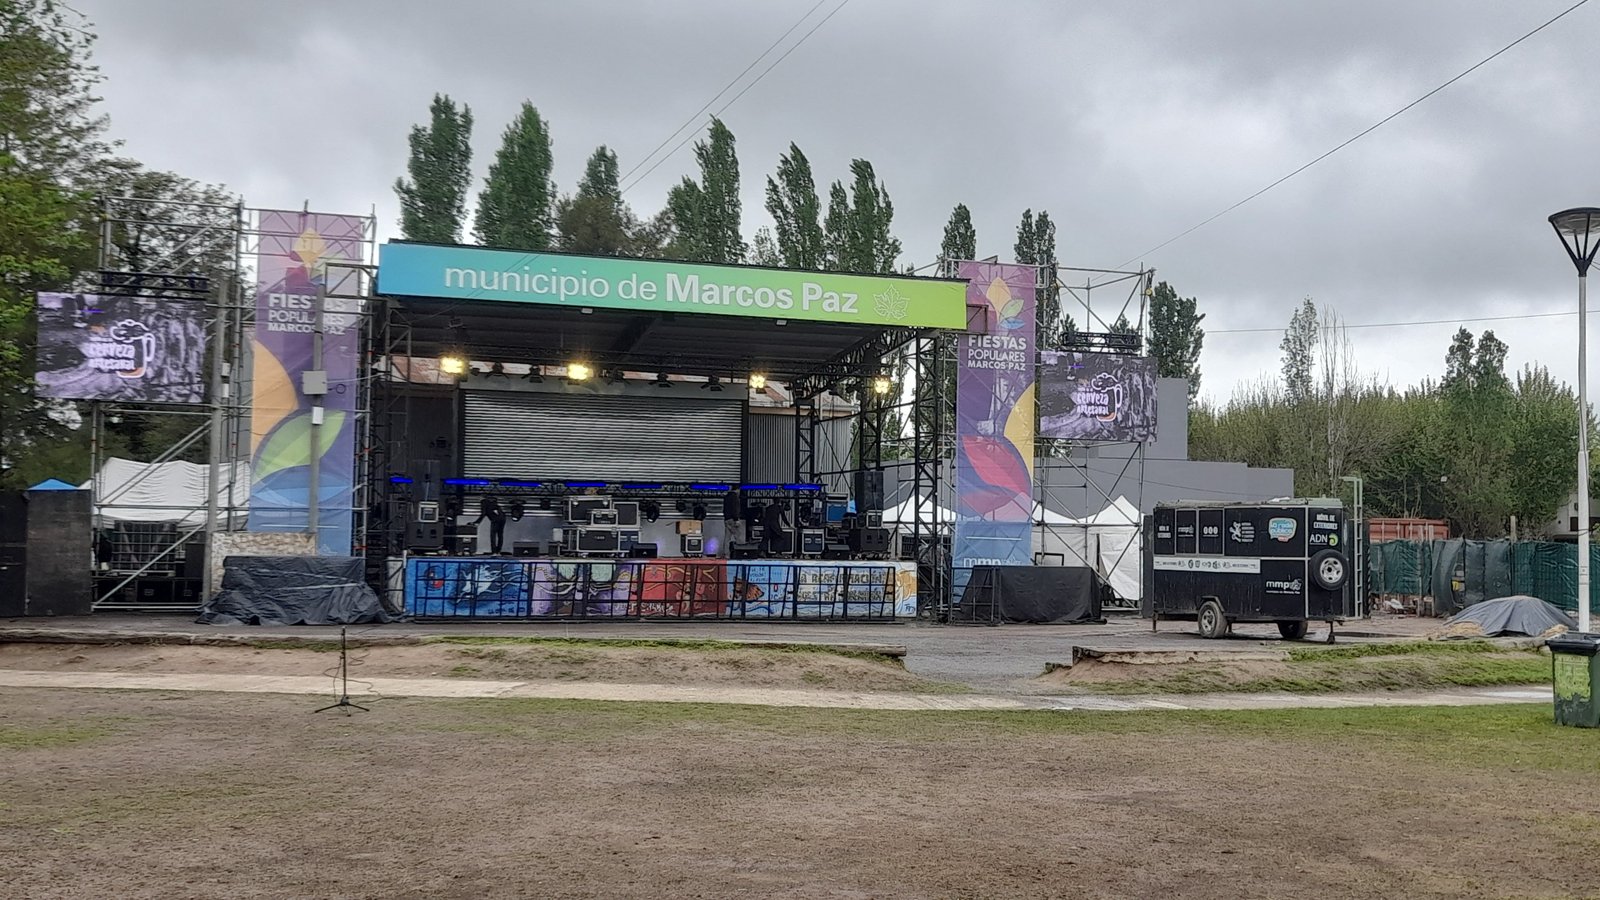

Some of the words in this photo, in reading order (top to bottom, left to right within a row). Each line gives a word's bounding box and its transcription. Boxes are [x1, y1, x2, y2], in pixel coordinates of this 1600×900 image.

[445, 265, 610, 301] municipio
[618, 273, 657, 300] de
[666, 273, 794, 310] Marcos
[802, 282, 859, 314] Paz
[268, 309, 345, 325] POPULRES
[968, 335, 1027, 350] FIESTAS
[968, 348, 1026, 362] POPULARES
[967, 359, 1006, 370] MARCOS
[1008, 362, 1026, 371] PAZ
[1309, 533, 1328, 543] ADN
[1265, 581, 1290, 590] mmp
